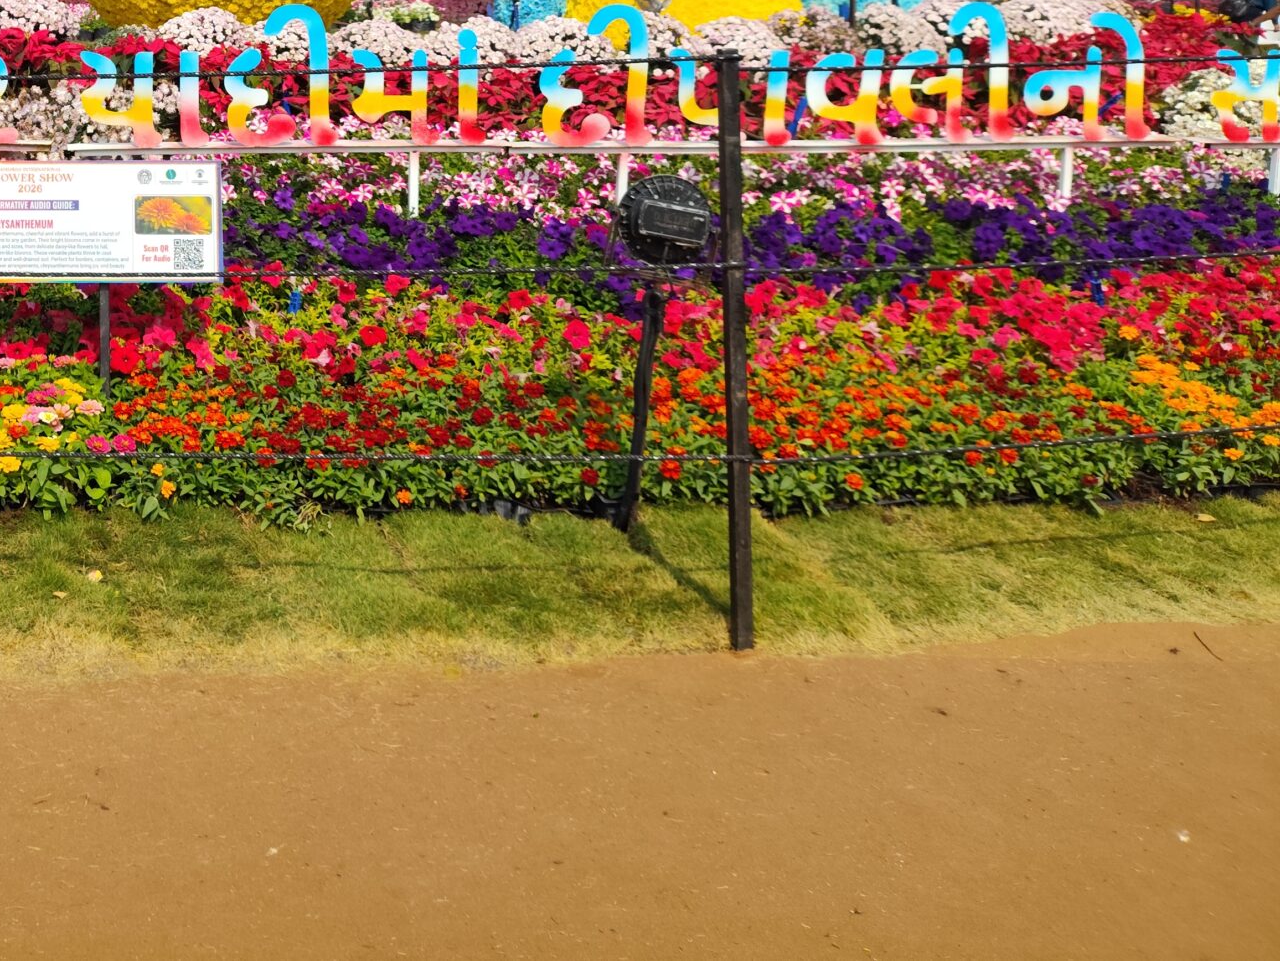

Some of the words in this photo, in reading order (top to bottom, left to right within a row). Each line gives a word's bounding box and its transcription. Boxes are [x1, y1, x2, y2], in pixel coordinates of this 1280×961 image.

[80, 3, 487, 147] યાદીમાં
[39, 173, 74, 183] SHOW
[18, 184, 43, 193] 2026
[29, 201, 51, 210] AUDIO
[52, 201, 76, 210] GUIDE:
[159, 245, 169, 253] QR
